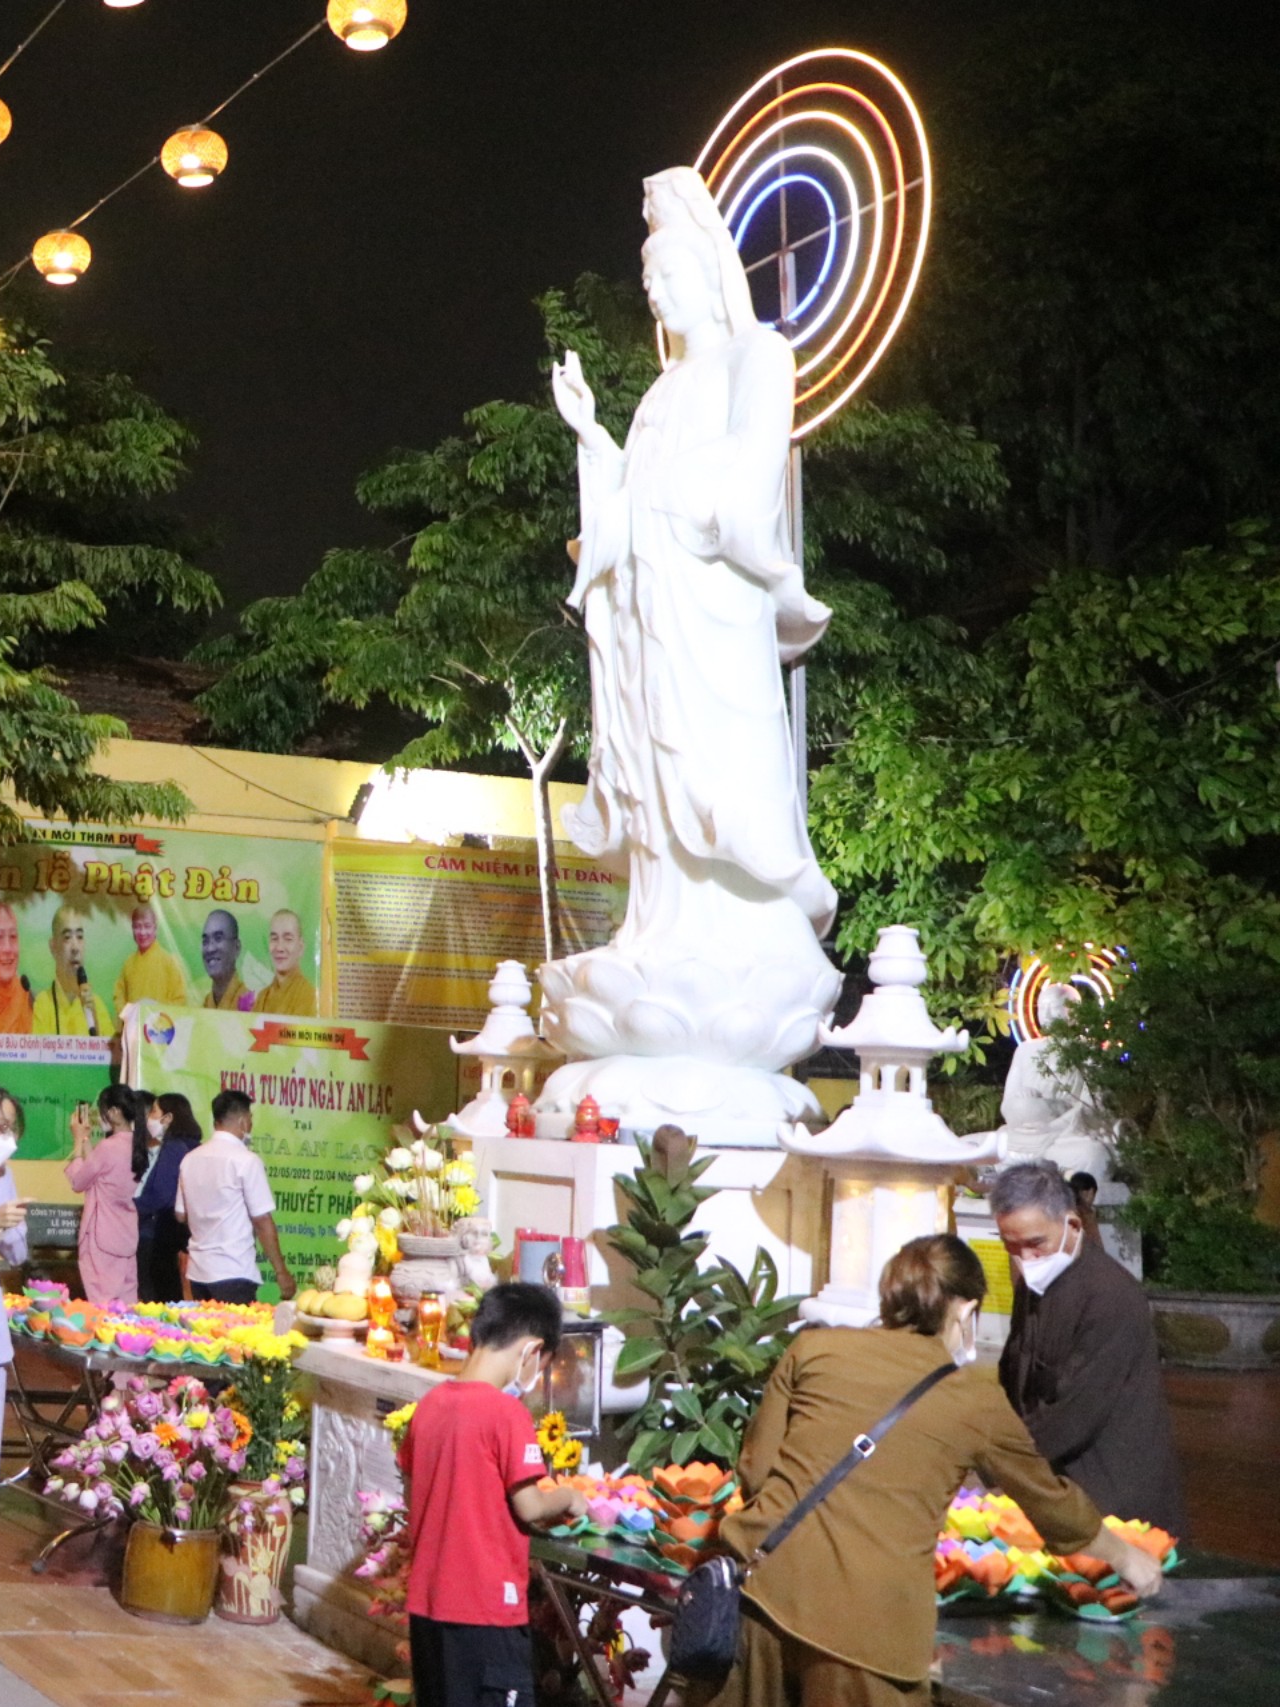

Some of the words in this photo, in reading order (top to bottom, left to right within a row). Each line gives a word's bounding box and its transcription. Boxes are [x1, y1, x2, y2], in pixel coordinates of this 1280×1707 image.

[51, 828, 75, 841] MỜI
[80, 832, 114, 844] THAM
[34, 851, 71, 892] lễ
[82, 861, 175, 901] Phật
[184, 866, 261, 903] Đản
[424, 852, 466, 872] CẢM
[471, 857, 519, 878] NIỆM
[260, 1074, 277, 1105] TU
[279, 1067, 306, 1114] MỘT
[309, 1071, 345, 1112] NGÀY
[347, 1082, 366, 1113] AN
[367, 1084, 393, 1120] LẠC
[274, 1186, 324, 1213] THUYẾT
